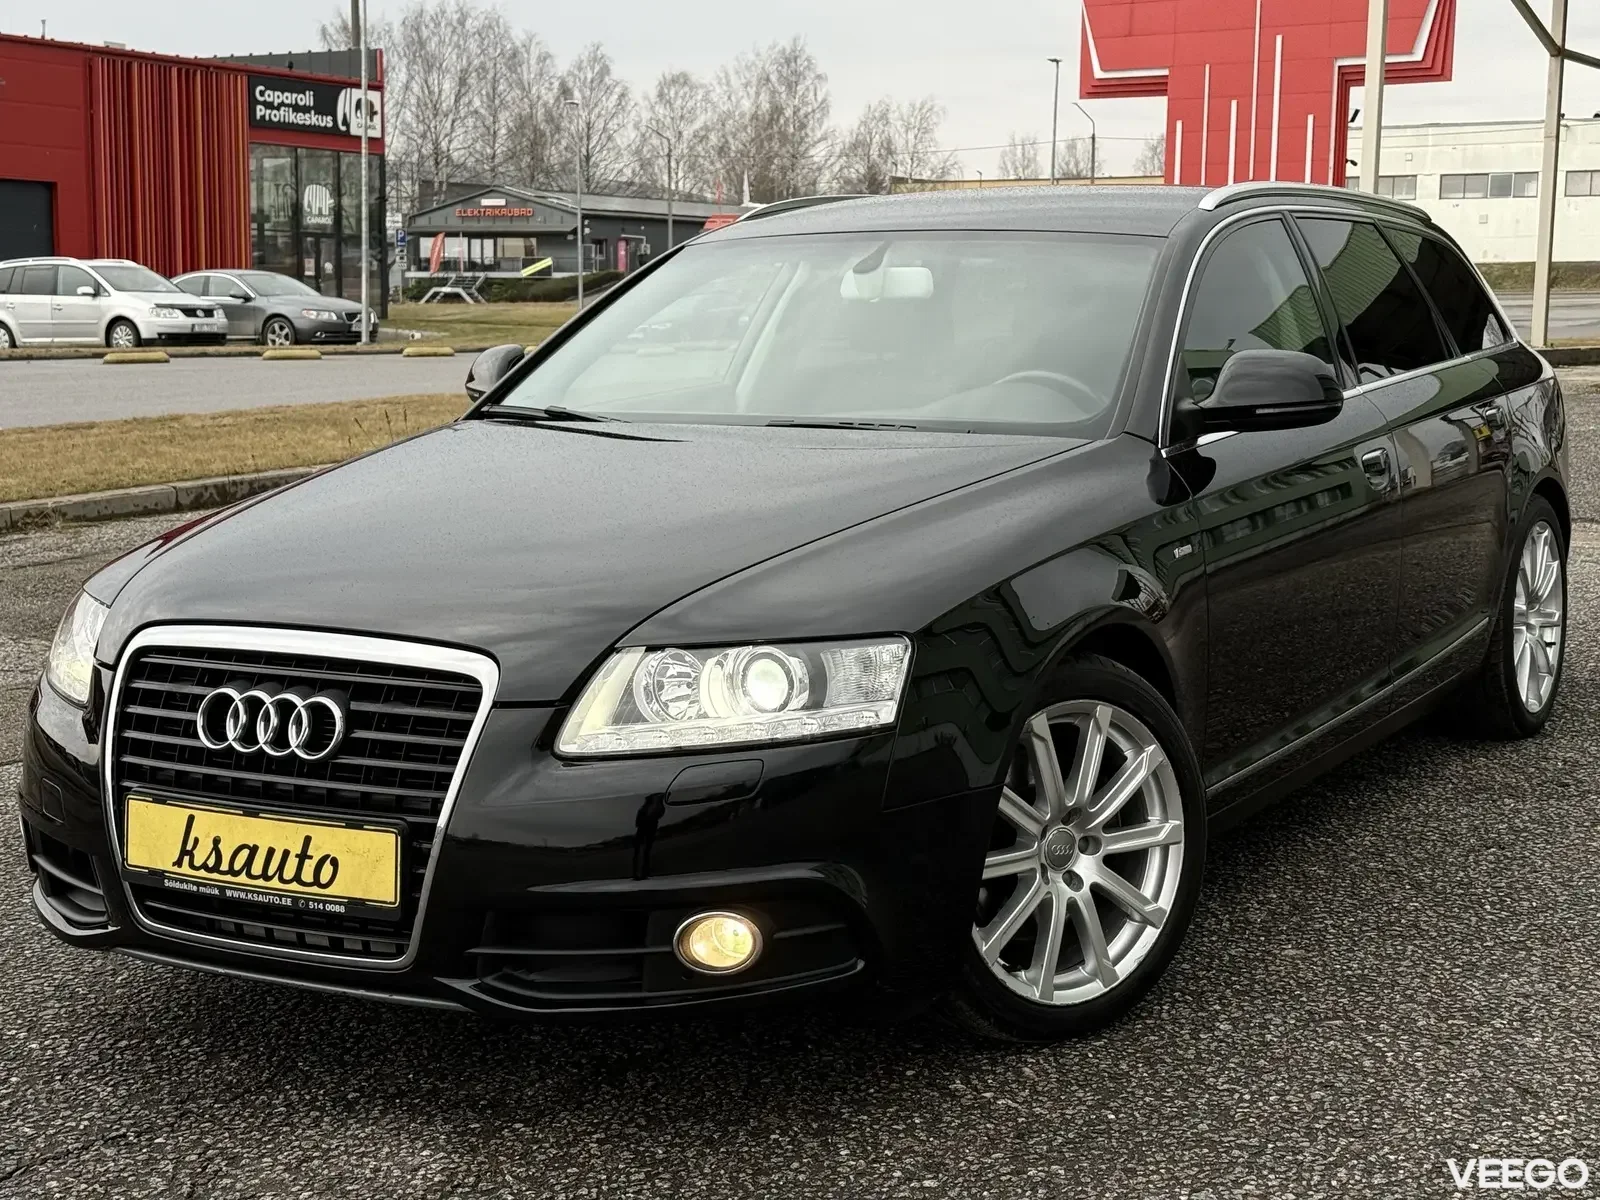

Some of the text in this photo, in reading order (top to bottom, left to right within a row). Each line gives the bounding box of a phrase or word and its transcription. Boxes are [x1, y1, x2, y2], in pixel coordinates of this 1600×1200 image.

[255, 85, 314, 107] Caparoli
[255, 105, 334, 127] Profikeskus
[172, 814, 340, 889] ksauto
[225, 889, 292, 906] WWW.KSAUTO.EE
[308, 901, 324, 911] 514
[325, 903, 345, 913] 0088
